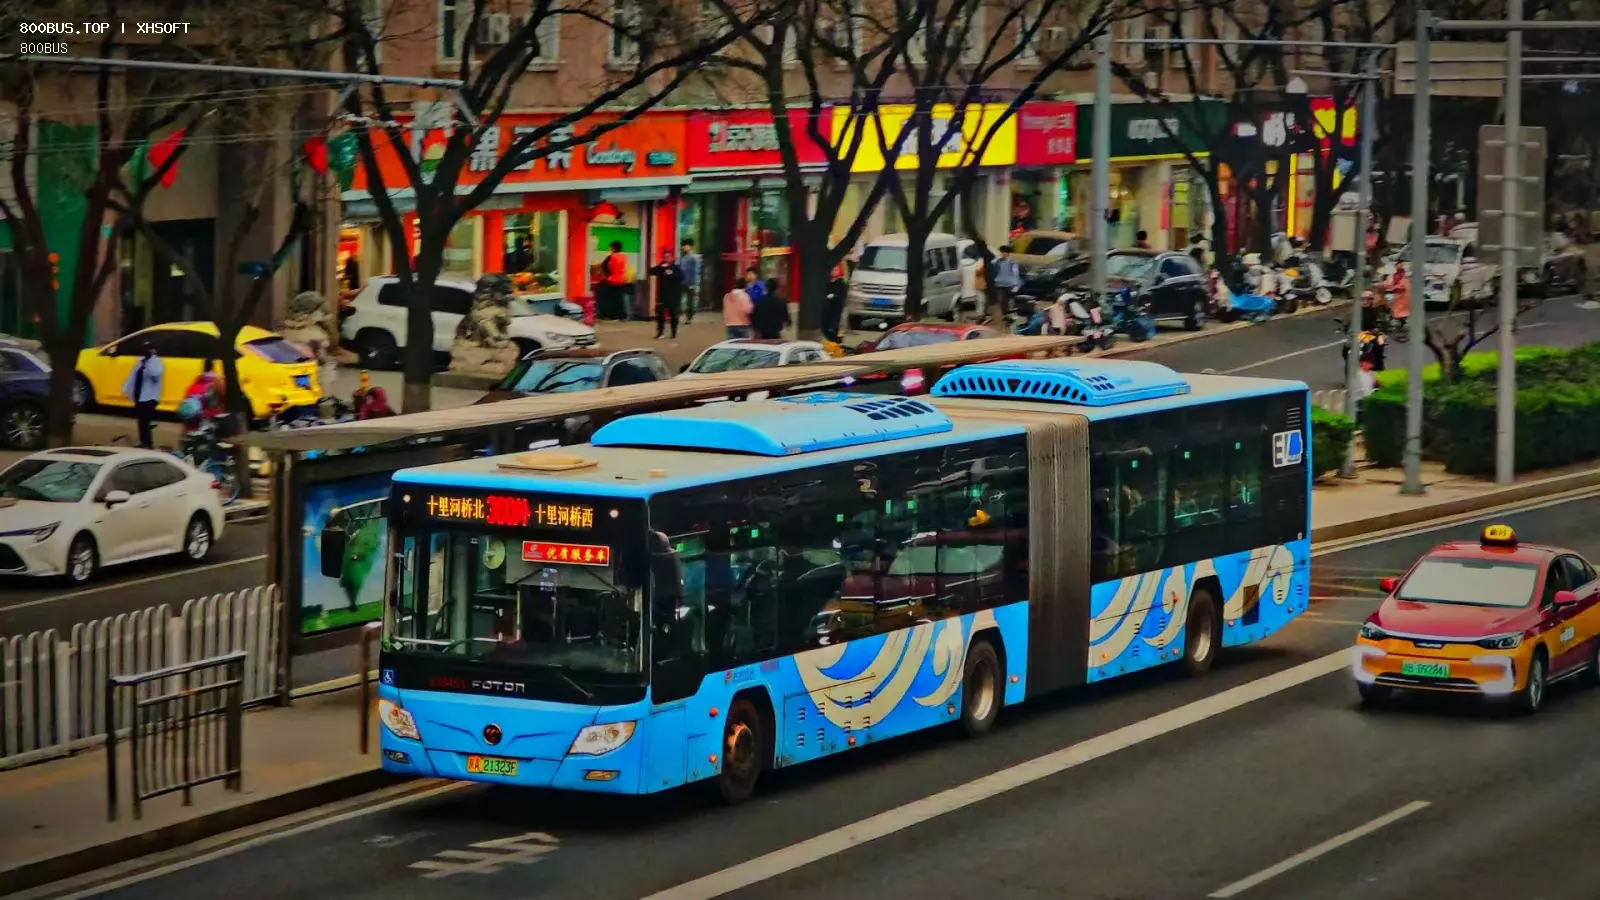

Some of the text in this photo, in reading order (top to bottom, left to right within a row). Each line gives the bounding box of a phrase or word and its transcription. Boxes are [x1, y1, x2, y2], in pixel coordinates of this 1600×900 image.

[426, 495, 485, 519] 十里河桥北
[534, 503, 593, 528] 十里河桥西
[546, 546, 606, 563] 优质服务车
[471, 679, 525, 693] FOTON
[483, 759, 517, 774] 21323F
